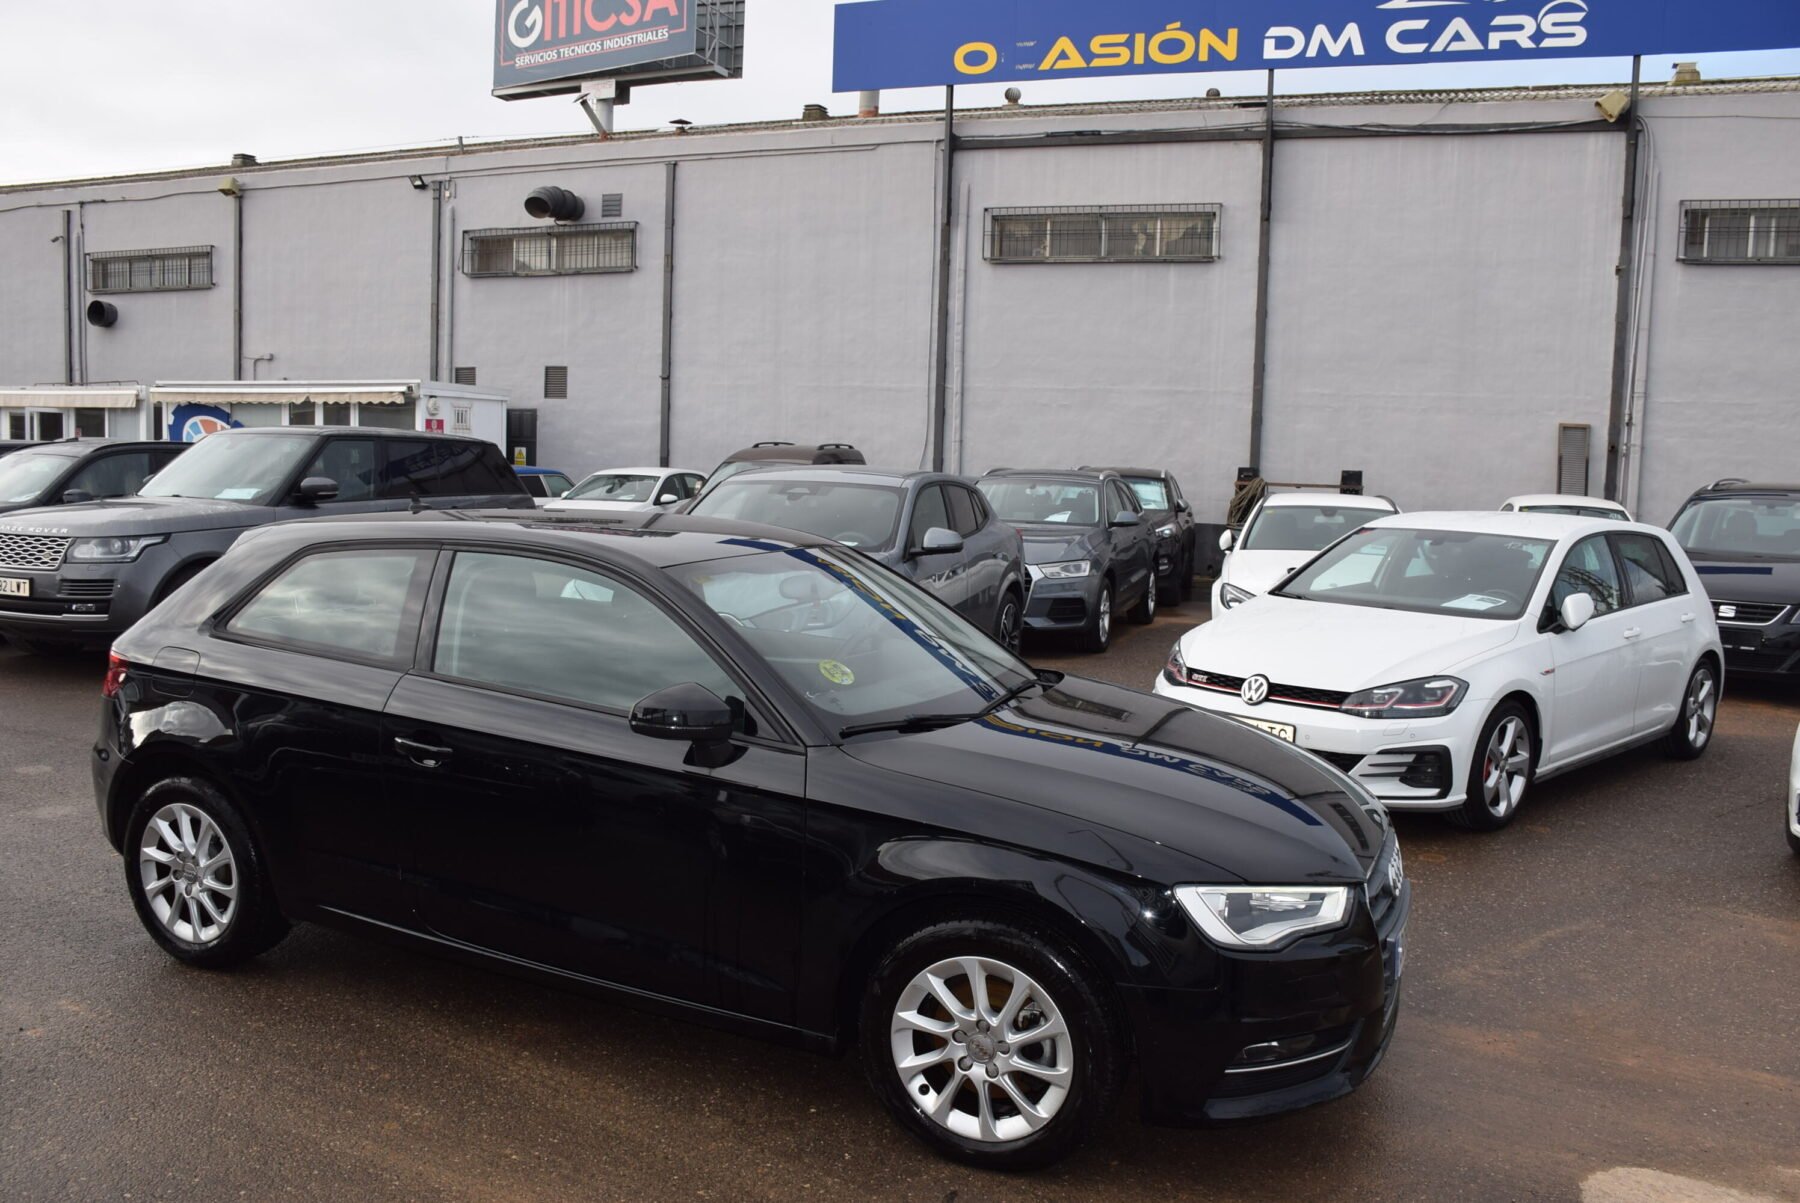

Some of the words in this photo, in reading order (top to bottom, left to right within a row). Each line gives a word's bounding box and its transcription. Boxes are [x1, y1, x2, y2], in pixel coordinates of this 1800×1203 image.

[515, 49, 558, 68] SERVICIOS
[559, 41, 602, 59] TECNICOS
[603, 28, 669, 50] INDUSTRIALES
[953, 21, 1239, 75] OASIÓN
[1263, 22, 1366, 60] DM
[1385, 11, 1589, 53] CARS
